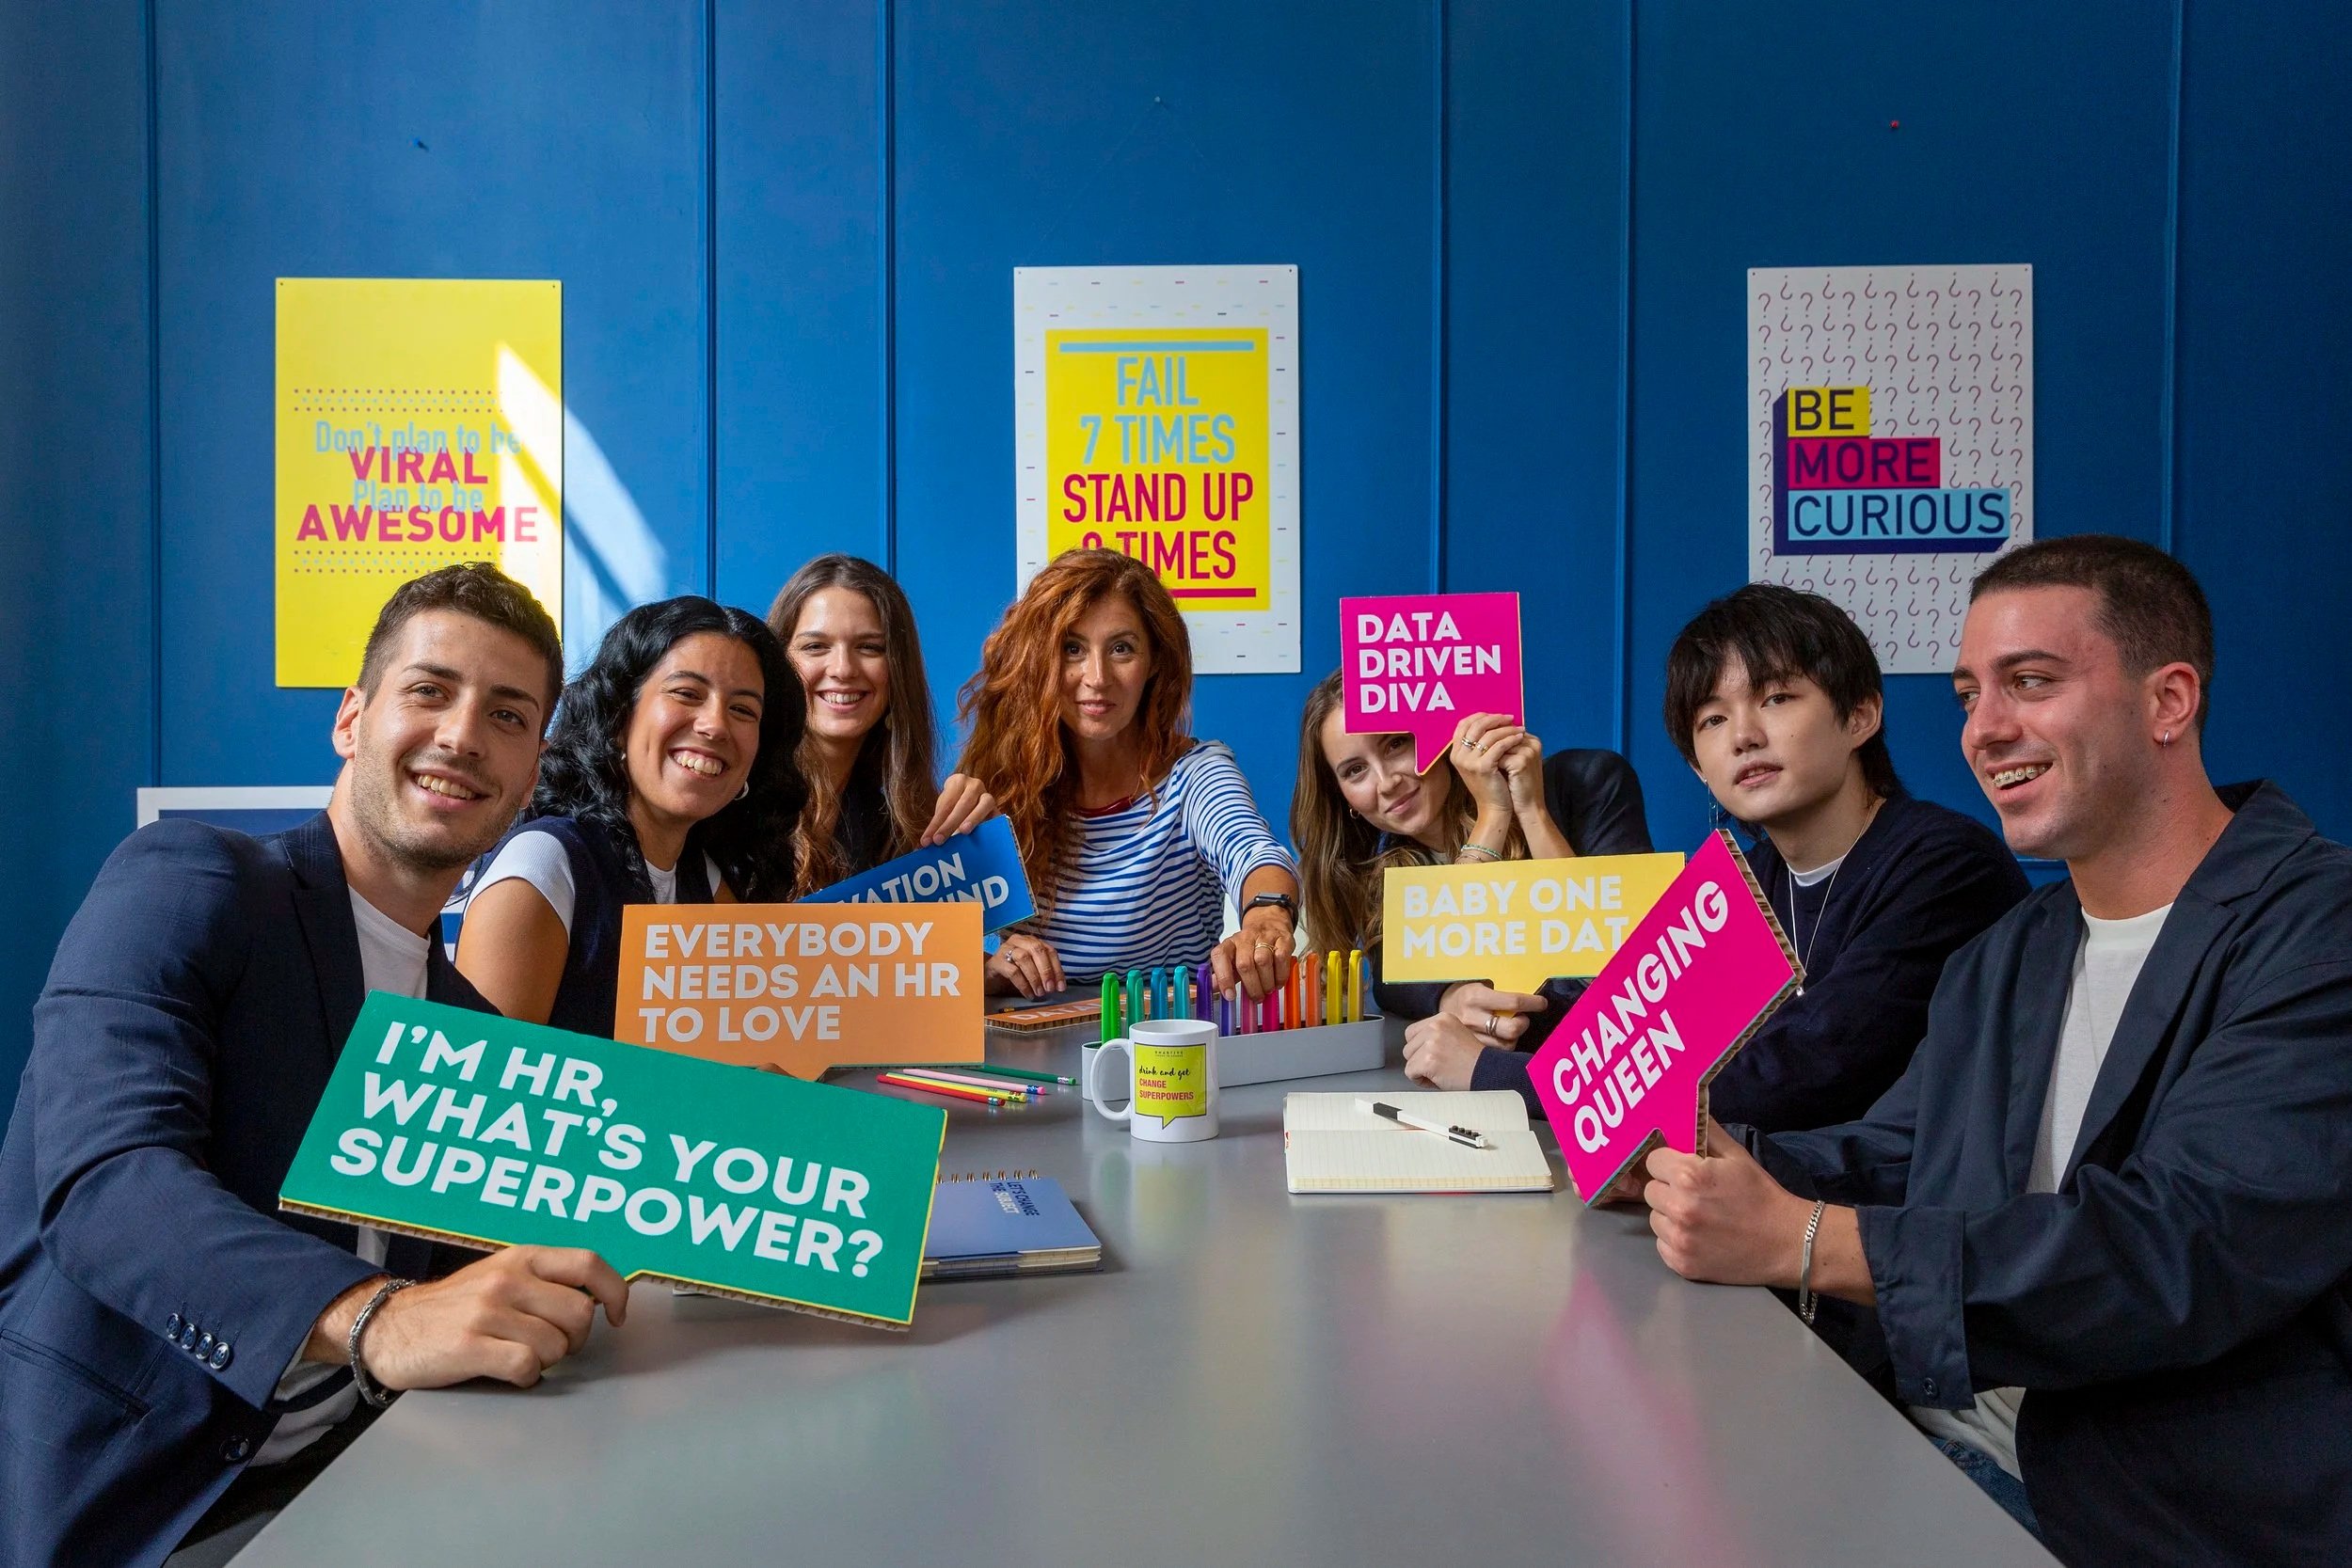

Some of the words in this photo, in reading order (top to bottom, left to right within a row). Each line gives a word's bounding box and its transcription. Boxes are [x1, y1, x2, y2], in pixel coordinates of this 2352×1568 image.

[1117, 356, 1199, 405] FAIL
[1794, 389, 1854, 431] BE
[315, 420, 383, 452] Don't
[391, 421, 448, 461] plan
[456, 425, 481, 453] to
[490, 422, 521, 453] be
[1080, 416, 1102, 465] 7
[1115, 414, 1235, 464] TIMES
[347, 446, 488, 483] VIRAL
[1795, 441, 1931, 483] MORE
[353, 479, 409, 512] Plan
[419, 482, 442, 512] to
[453, 481, 484, 512] be
[1063, 473, 1186, 523] STAND
[1203, 472, 1253, 521] UP
[1794, 493, 2005, 536] CURIOUS
[296, 504, 539, 543] AWESOME
[1116, 531, 1236, 579] TIMES
[1358, 611, 1462, 643] DATA
[1359, 645, 1501, 678] DRIVEN
[1360, 682, 1455, 713] DIVA
[1403, 880, 1518, 918] BABY
[1529, 876, 1622, 912] ONE
[644, 922, 933, 958] EVERYBODY
[1403, 922, 1526, 958] MORE
[1540, 916, 1629, 954] DAT
[643, 964, 799, 1000] NEEDS
[809, 963, 879, 998] AN
[895, 962, 961, 997] HR
[1552, 880, 1728, 1105] CHANGING
[639, 1006, 704, 1042] TO
[718, 1006, 840, 1041] LOVE
[374, 1022, 488, 1082] I'M
[498, 1046, 618, 1117] HR,
[1138, 1065, 1159, 1075] drink
[1159, 1068, 1176, 1077] and
[1177, 1068, 1191, 1081] get
[1139, 1078, 1167, 1088] CHANGE
[1574, 1009, 1686, 1153] QUEEN
[1139, 1090, 1194, 1101] SUPERPOWERS
[363, 1070, 646, 1171] WHAT'S
[669, 1132, 870, 1218] YOUR
[330, 1128, 883, 1278] SUPERPOWER?
[989, 1181, 1007, 1193] THE
[1014, 1192, 1041, 1216] CHANGE
